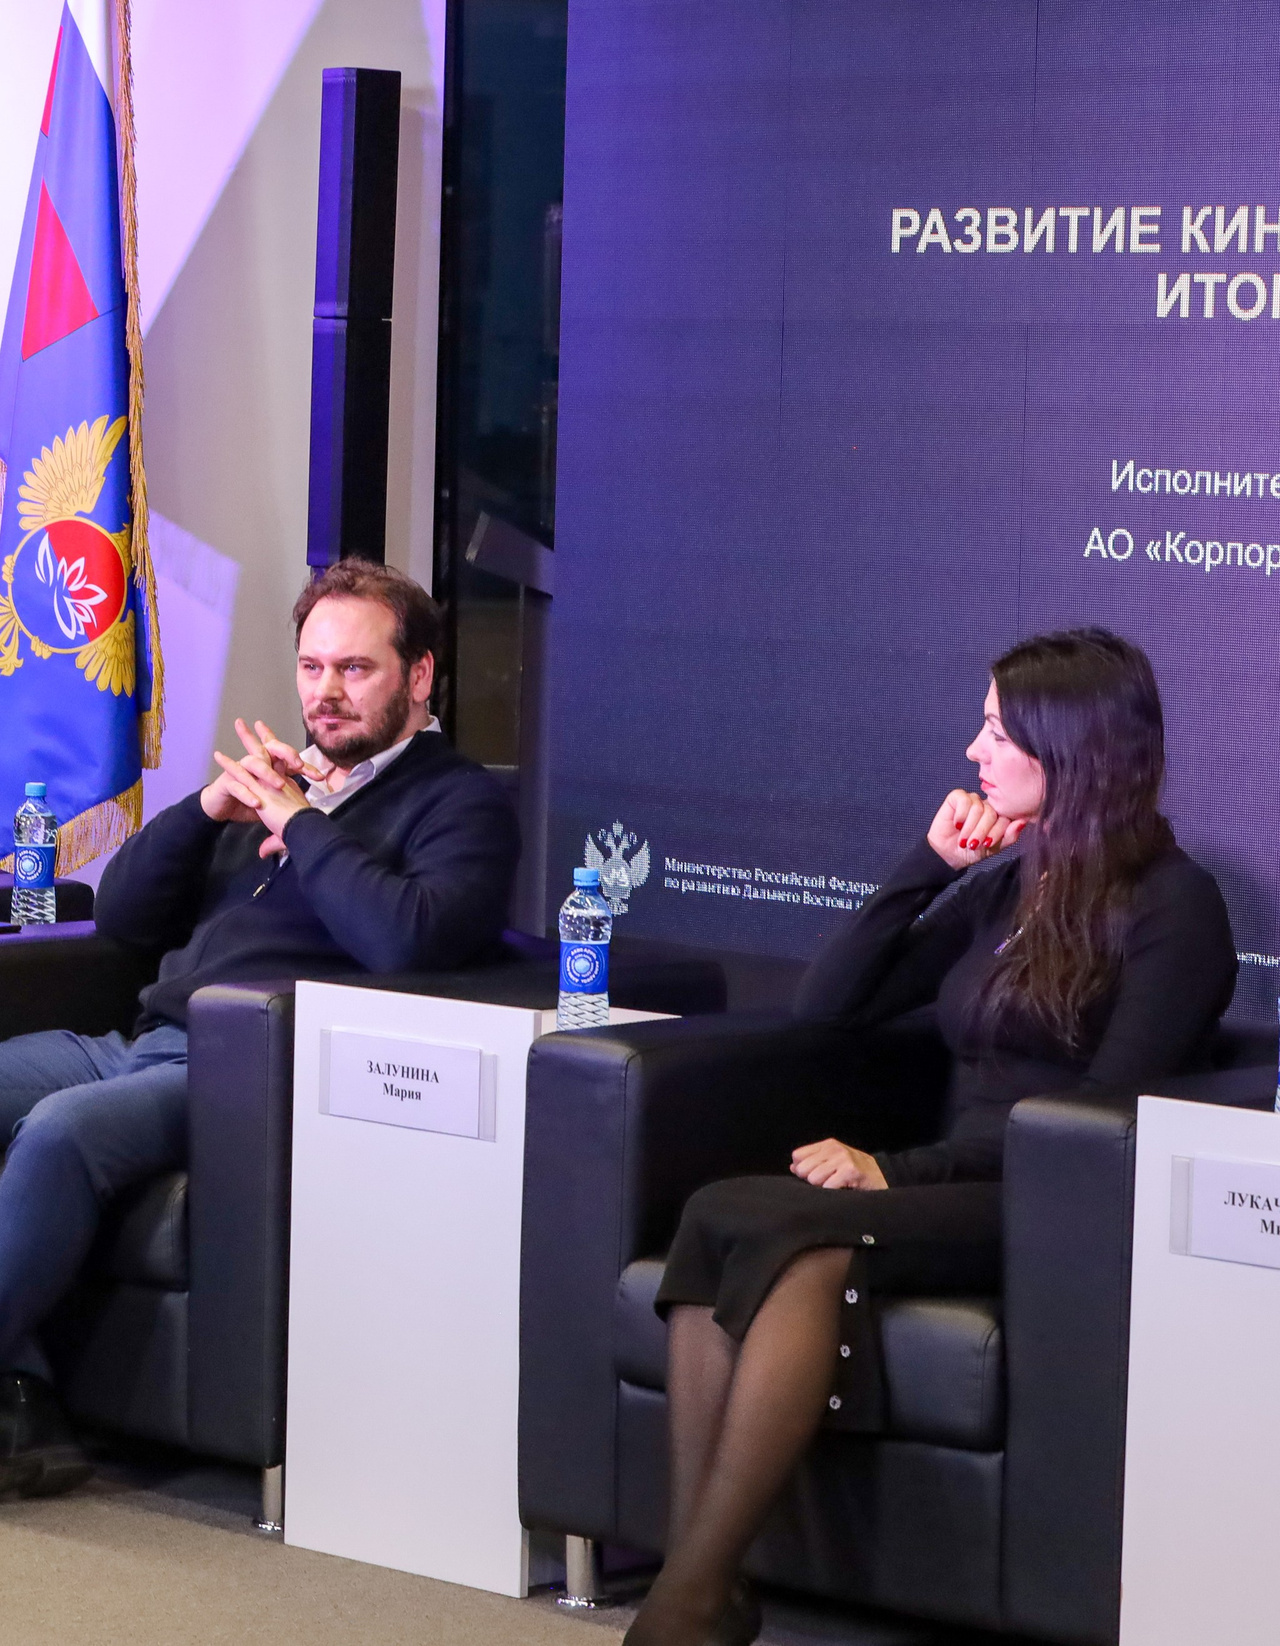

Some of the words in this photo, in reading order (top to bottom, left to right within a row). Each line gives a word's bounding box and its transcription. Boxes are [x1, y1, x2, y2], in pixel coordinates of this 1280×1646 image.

[891, 206, 1162, 253] РАЗВИТИЕ
[1181, 205, 1280, 253] КИН
[1082, 527, 1134, 561] АО
[664, 857, 752, 880] Министерство
[754, 867, 825, 889] Российской
[828, 875, 883, 896] Федера
[664, 877, 680, 889] по
[681, 878, 741, 895] развитию
[742, 883, 801, 905] Дальнего
[803, 891, 853, 911] Востока
[366, 1060, 440, 1084] ЗАЛУНИНА
[383, 1082, 422, 1102] Мария
